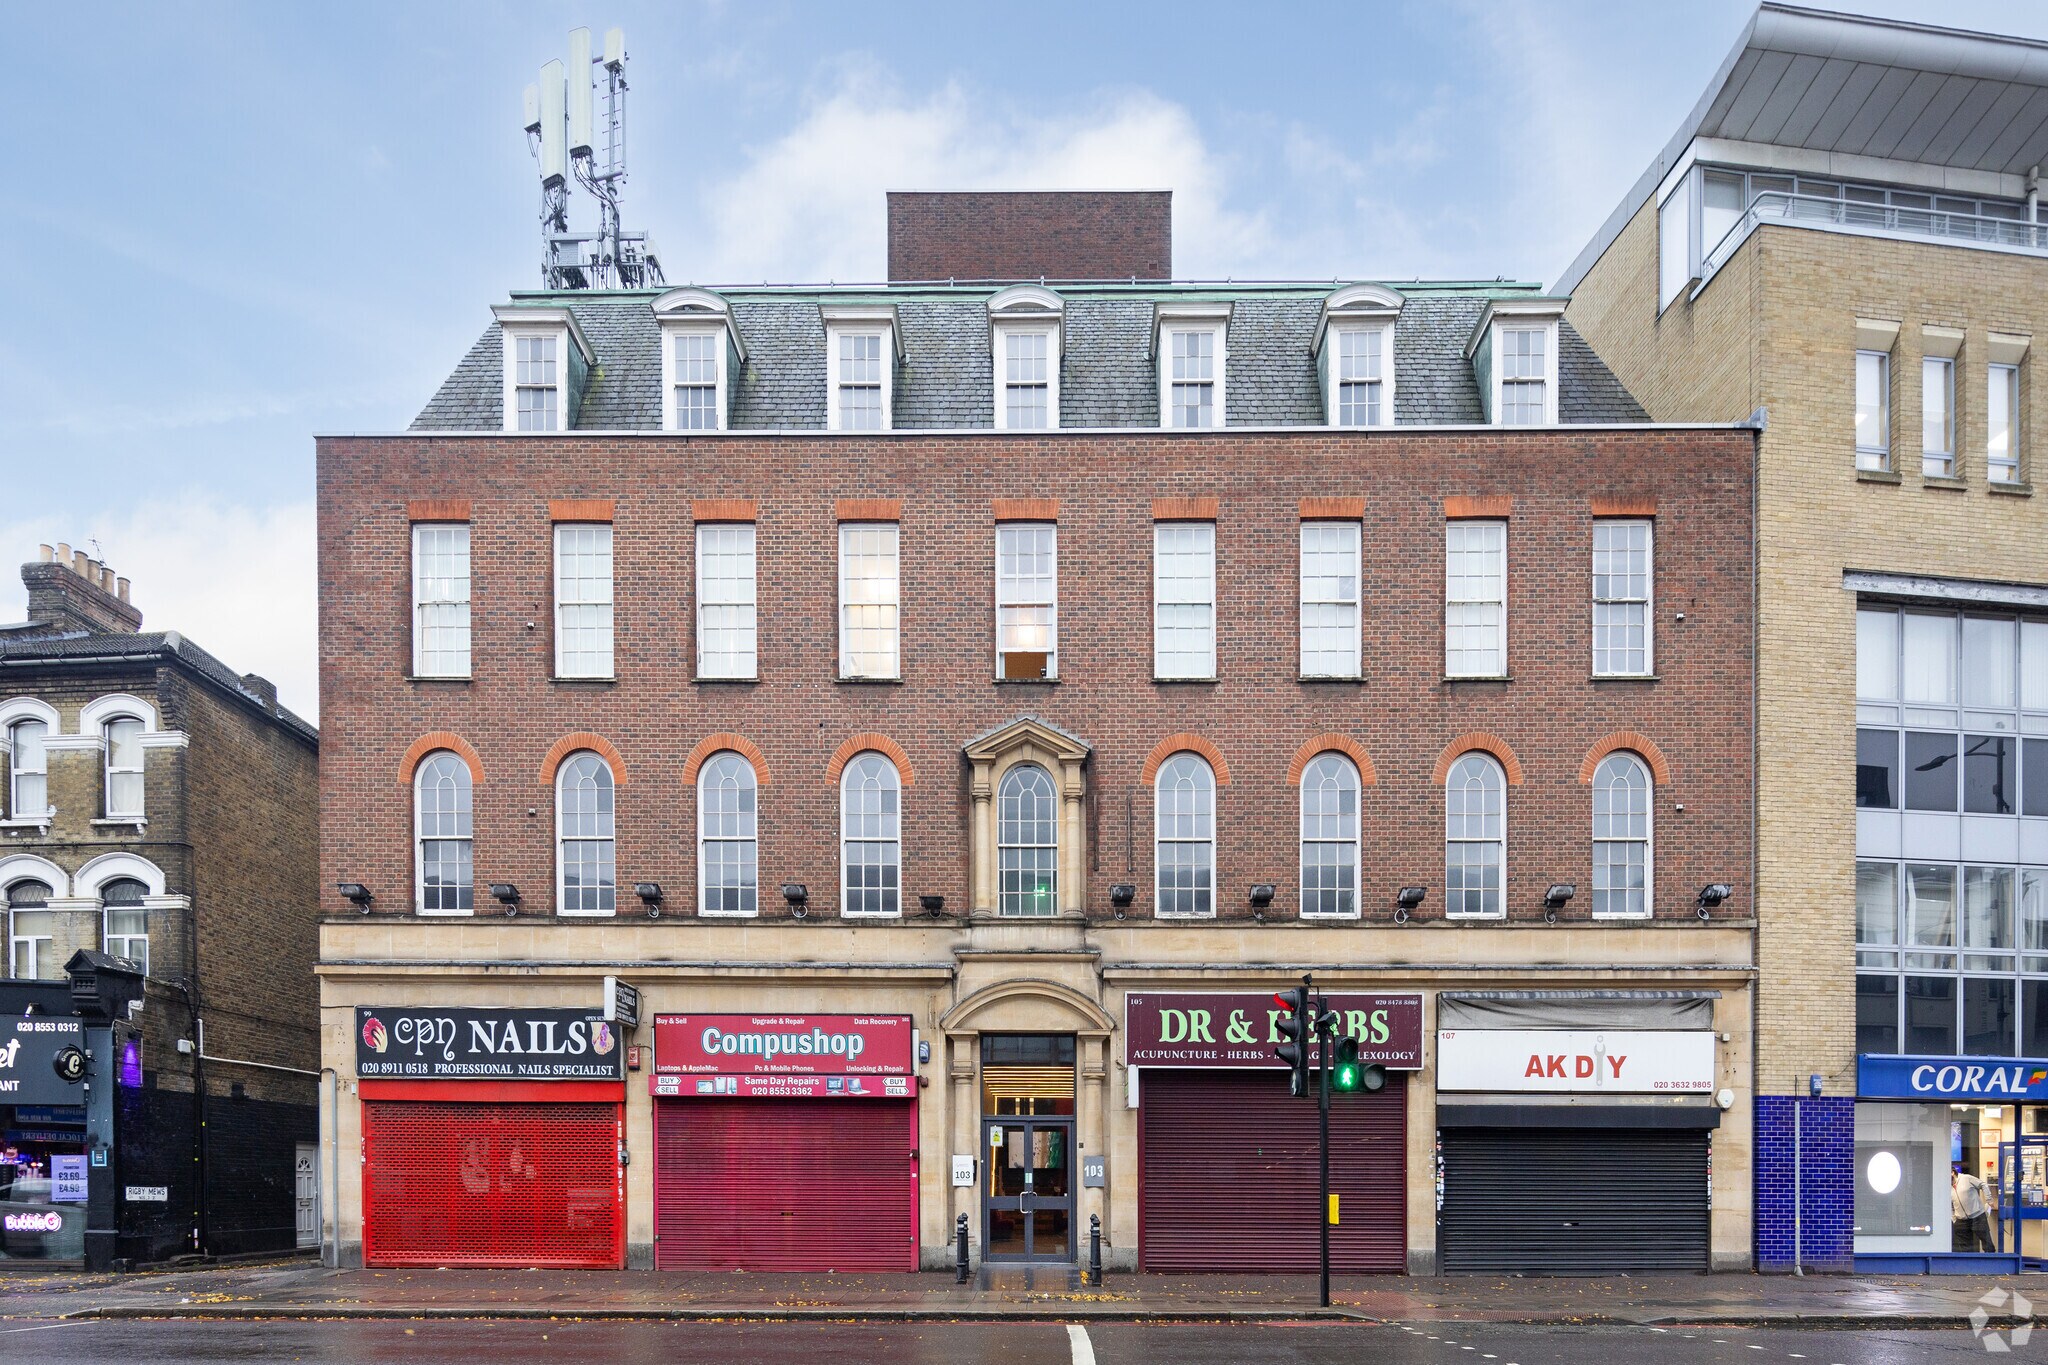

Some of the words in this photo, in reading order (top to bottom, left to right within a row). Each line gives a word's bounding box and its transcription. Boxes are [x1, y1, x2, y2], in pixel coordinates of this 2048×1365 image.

[17, 1022, 33, 1031] 020
[35, 1023, 56, 1031] 8553
[58, 1023, 78, 1032] 0312
[1159, 1009, 1216, 1043] DR
[1225, 1009, 1257, 1043] &
[468, 1020, 587, 1054] NAILS
[702, 1026, 864, 1061] Compushop
[1134, 1050, 1218, 1059] ACUPUNCTURE
[1228, 1050, 1264, 1059] HERBS
[1358, 1051, 1415, 1060] LEXOLOGY
[362, 1063, 379, 1073] 020
[381, 1063, 403, 1073] 8911
[405, 1063, 428, 1073] 0518
[434, 1064, 514, 1074] PROFESSIONAL
[518, 1064, 550, 1075] NAILS
[553, 1065, 613, 1075] SPECIALIST
[770, 1077, 785, 1087] Day
[788, 1078, 819, 1087] Repairs
[1912, 1065, 2027, 1093] CORAL
[59, 1172, 79, 1180] £3.69
[1084, 1165, 1103, 1177] 103
